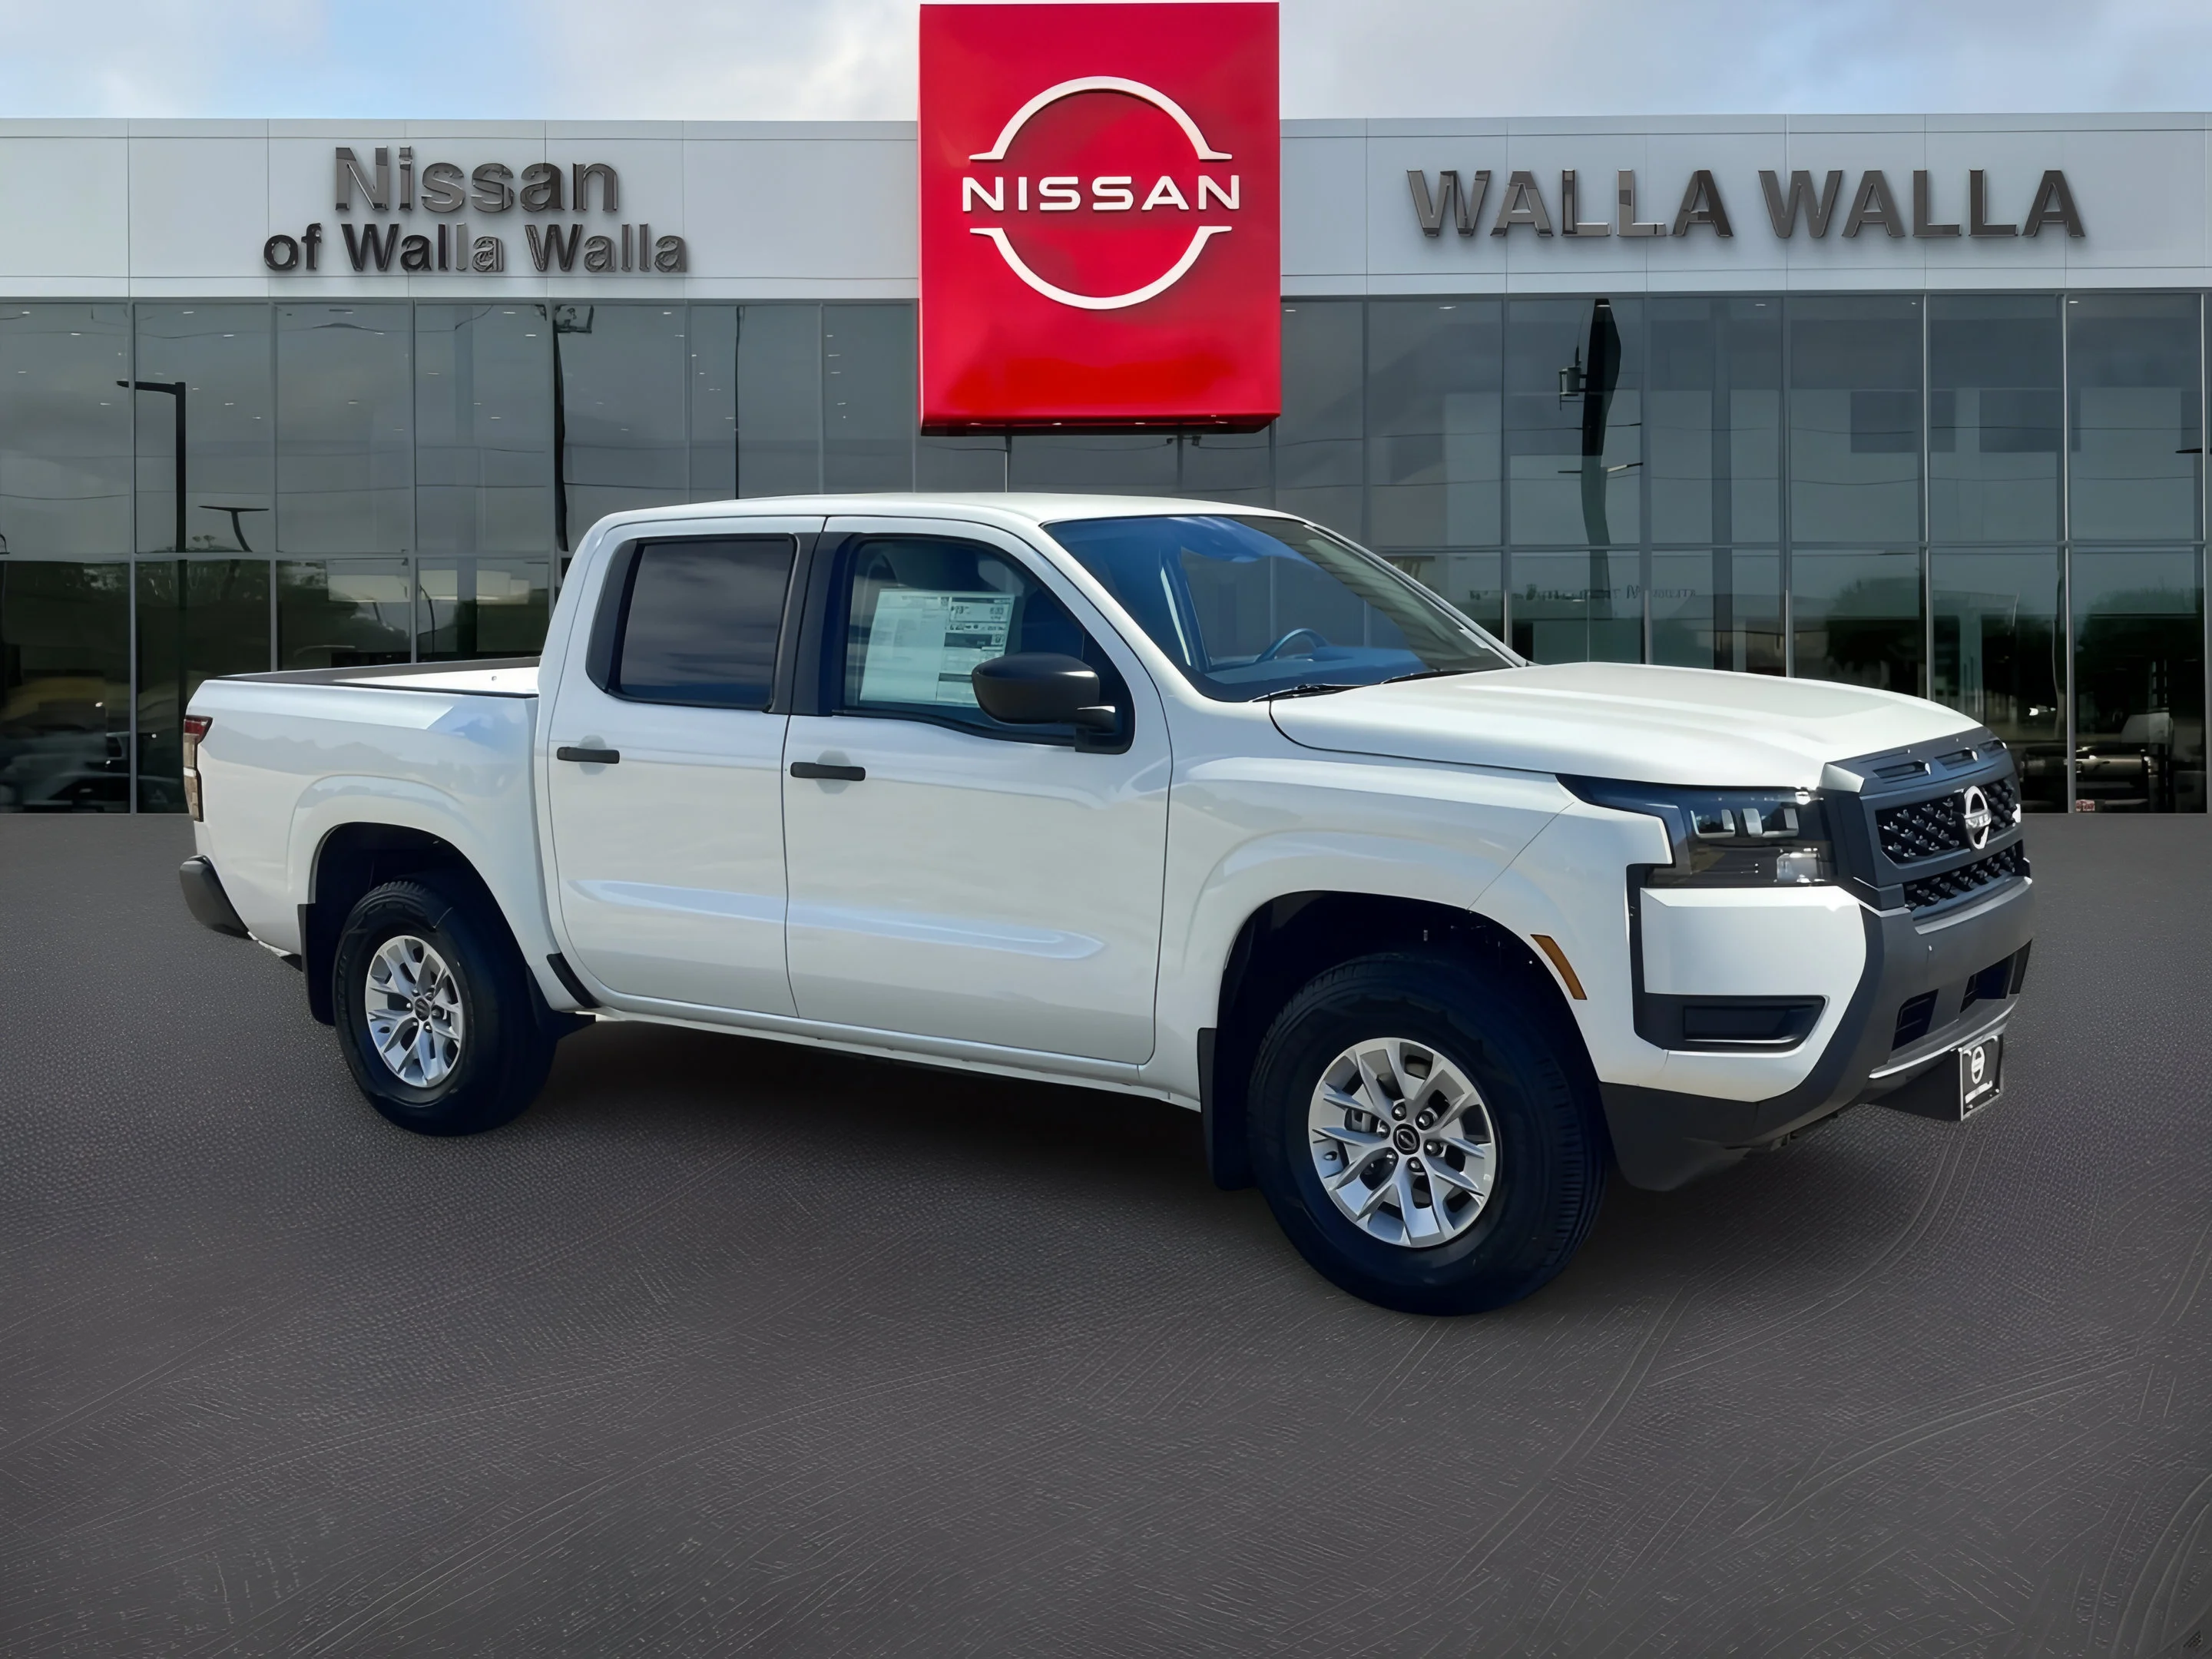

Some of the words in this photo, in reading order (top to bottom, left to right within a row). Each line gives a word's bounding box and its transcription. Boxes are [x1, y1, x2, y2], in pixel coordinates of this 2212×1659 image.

[335, 146, 619, 212] Nissan
[962, 175, 1240, 211] NISSAN
[1406, 169, 1734, 237] WALLA
[1757, 169, 2085, 238] WALLA
[263, 223, 323, 272] of
[341, 223, 503, 273] Walla
[524, 223, 687, 273] Walla
